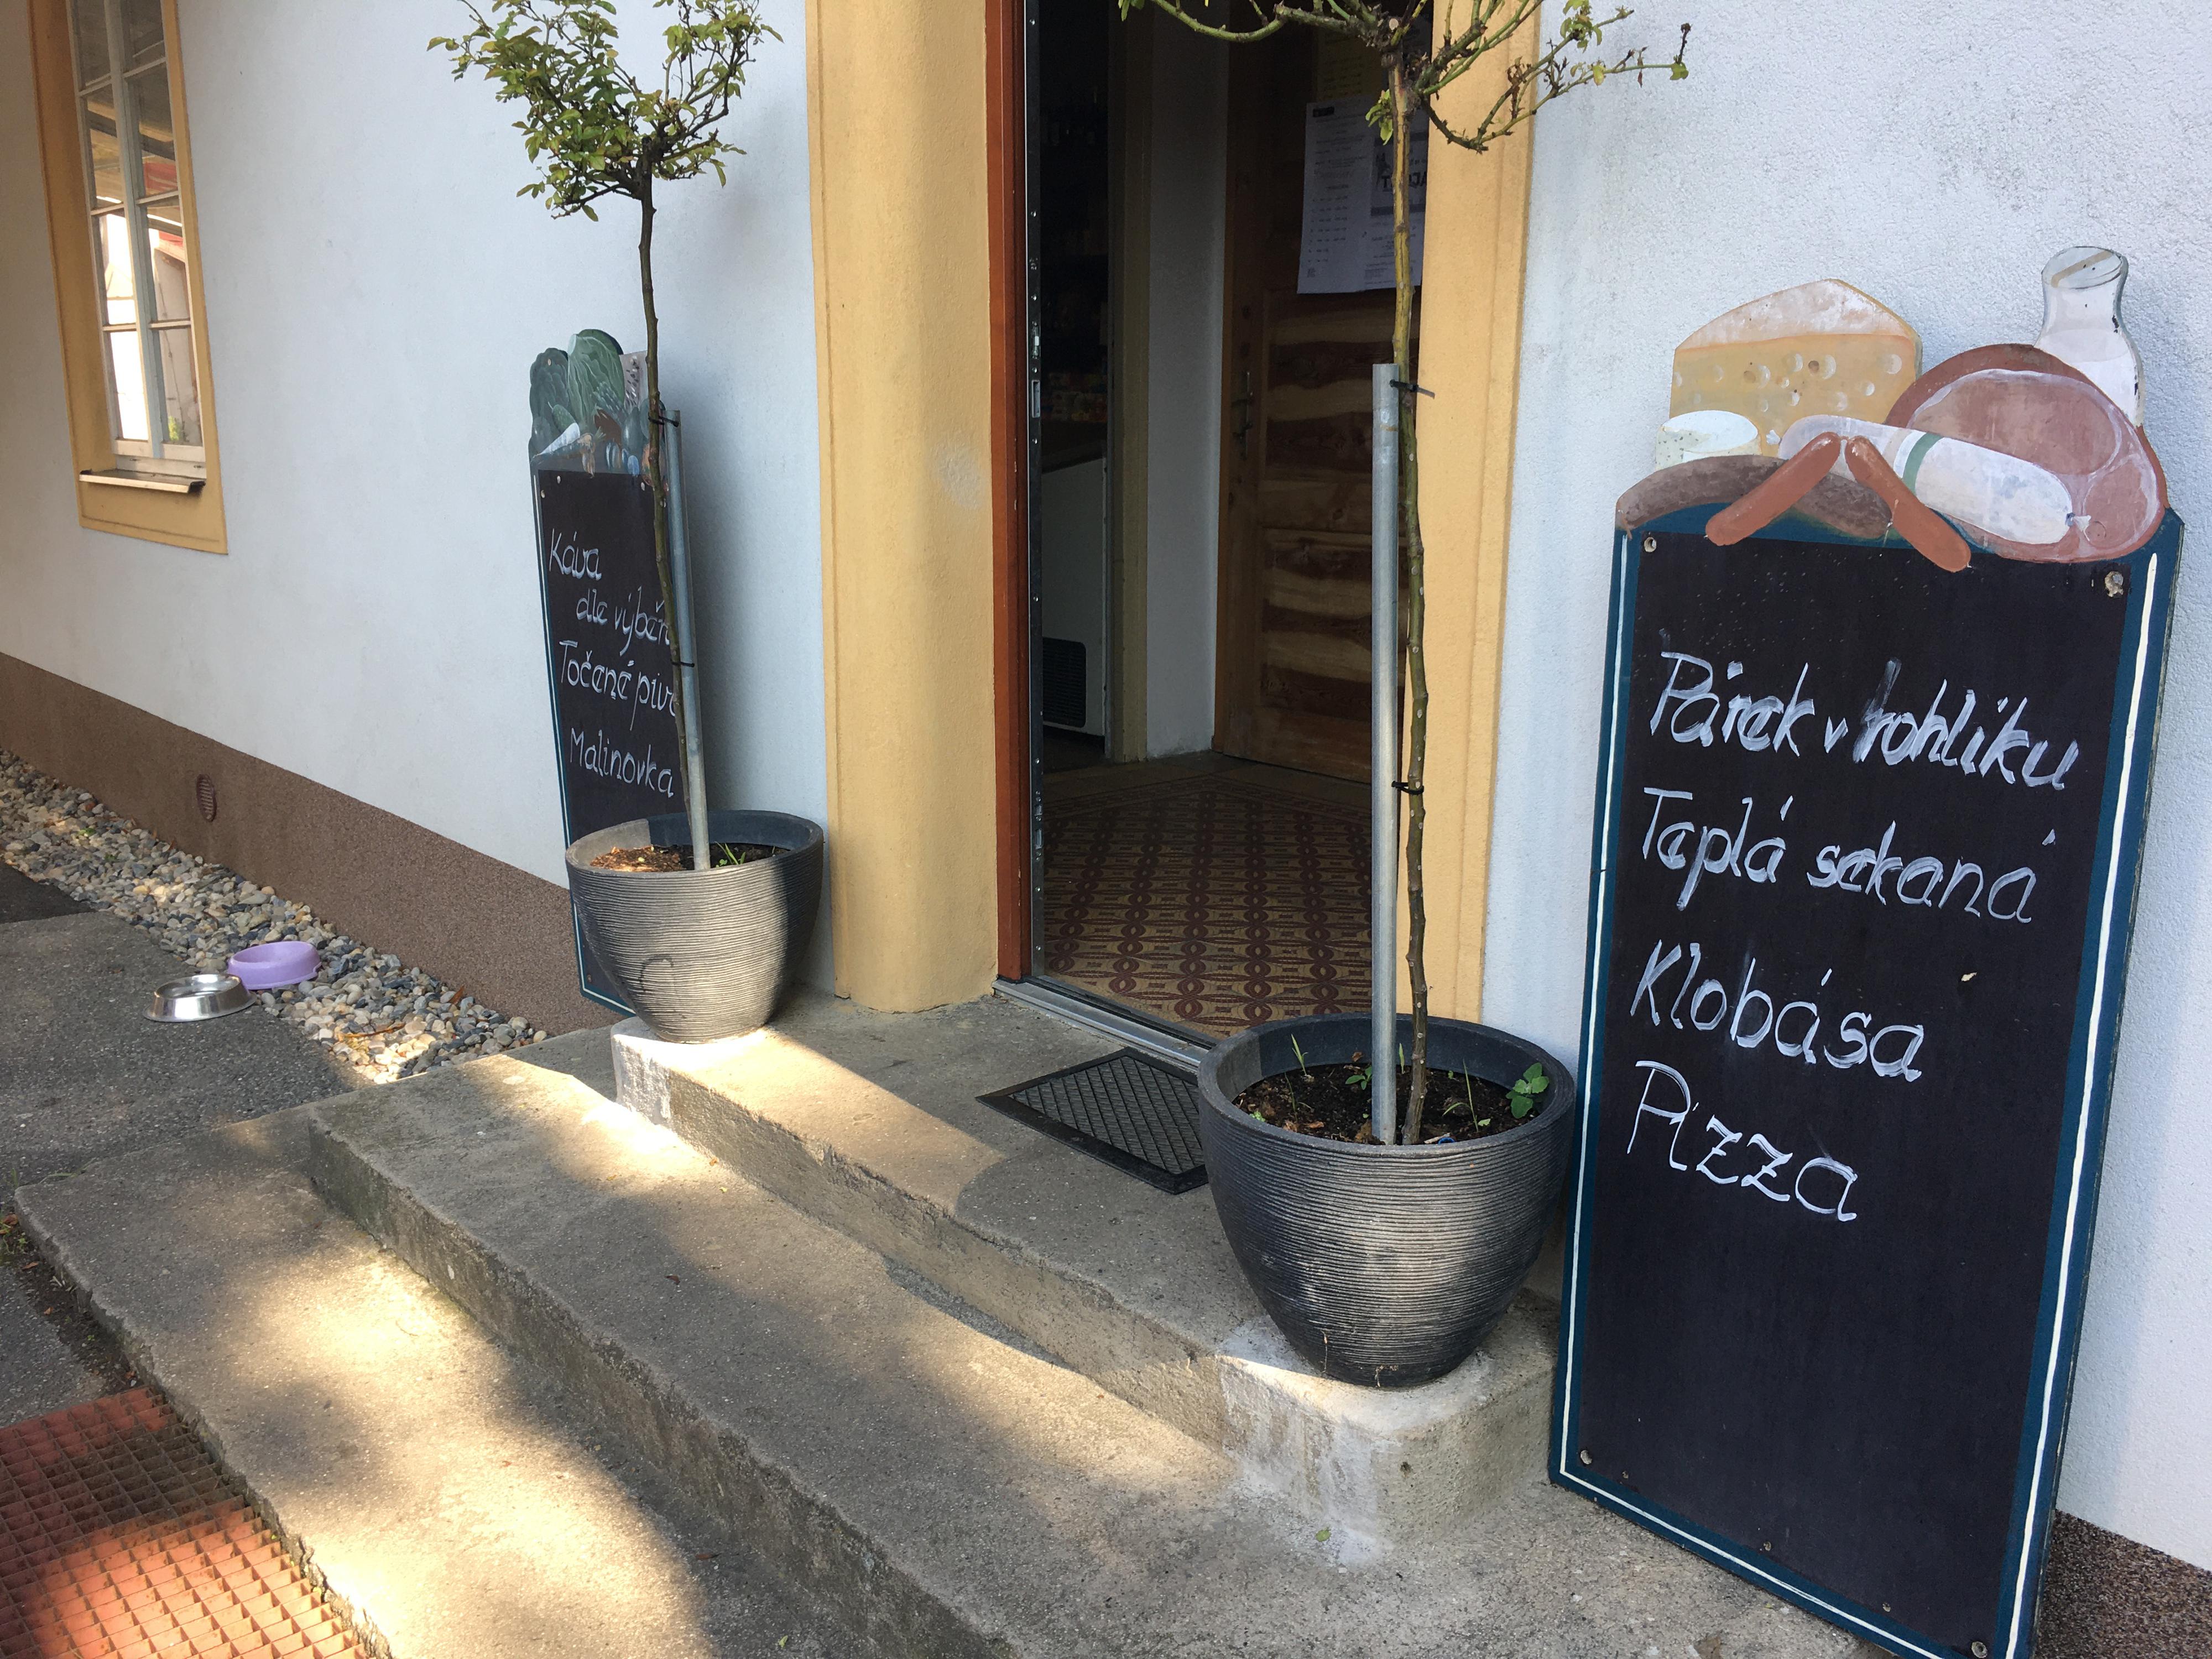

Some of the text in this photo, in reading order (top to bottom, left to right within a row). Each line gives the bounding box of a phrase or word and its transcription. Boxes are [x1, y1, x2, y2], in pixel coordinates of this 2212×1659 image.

[549, 528, 602, 581] Káva
[576, 588, 608, 625] dle
[559, 640, 635, 700] Točené
[1650, 650, 2080, 790] Párek v rohlíku
[570, 727, 674, 798] Malinovka
[1642, 786, 2057, 924] Teplá sekaná
[1630, 939, 1924, 1082] Klobása
[1626, 1060, 1858, 1222] Pizza
